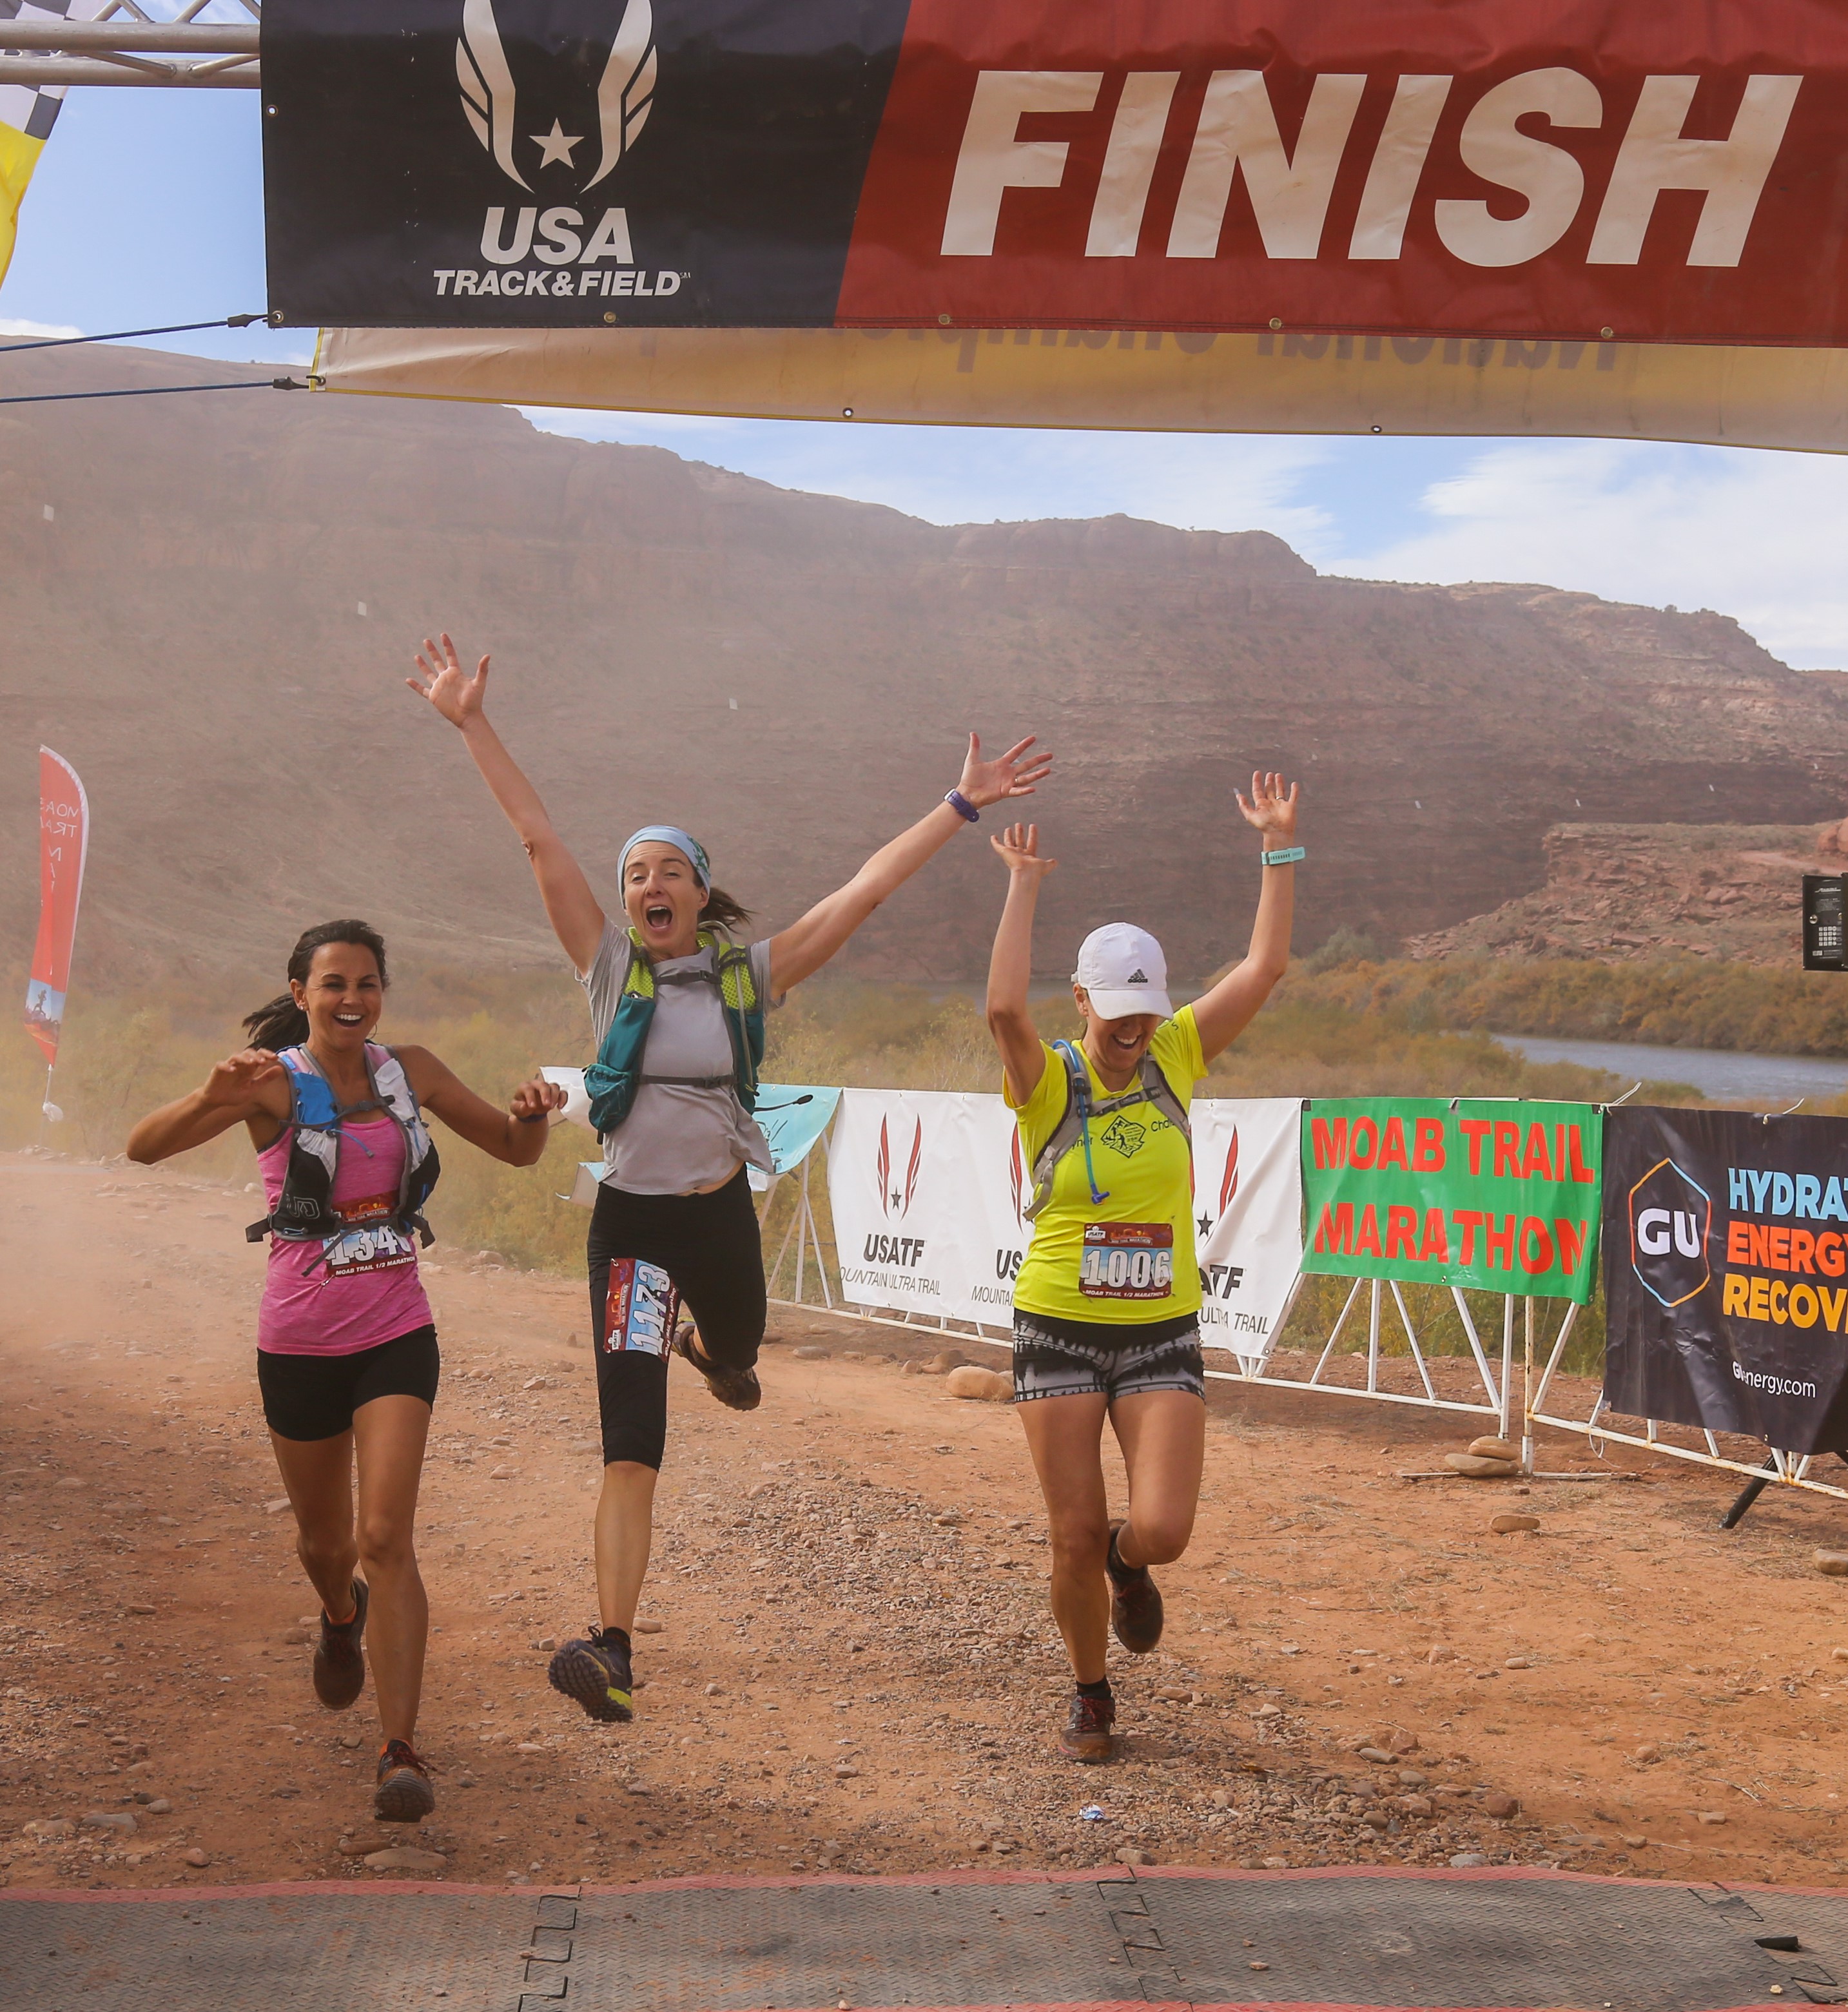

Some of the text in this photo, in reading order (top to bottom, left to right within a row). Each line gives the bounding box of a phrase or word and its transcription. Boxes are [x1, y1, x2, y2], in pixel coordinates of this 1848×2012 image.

[940, 67, 1804, 267] FINISH
[480, 207, 634, 265] USA
[433, 270, 681, 296] TRACK&FIELD
[1311, 1116, 1595, 1184] MOAB TRAIL
[1728, 1168, 1848, 1222] HYDRA
[863, 1233, 925, 1268] USATF
[1314, 1202, 1588, 1275] MARATHON
[1638, 1208, 1700, 1259] GU
[336, 1267, 355, 1275] MOAB
[890, 1273, 916, 1291] ULTRA
[918, 1278, 941, 1295] TRAIL
[1084, 1250, 1171, 1288] 1006
[631, 1265, 670, 1354] 1173
[1234, 1313, 1269, 1334] TRAIL
[1722, 1273, 1848, 1335] RECOV
